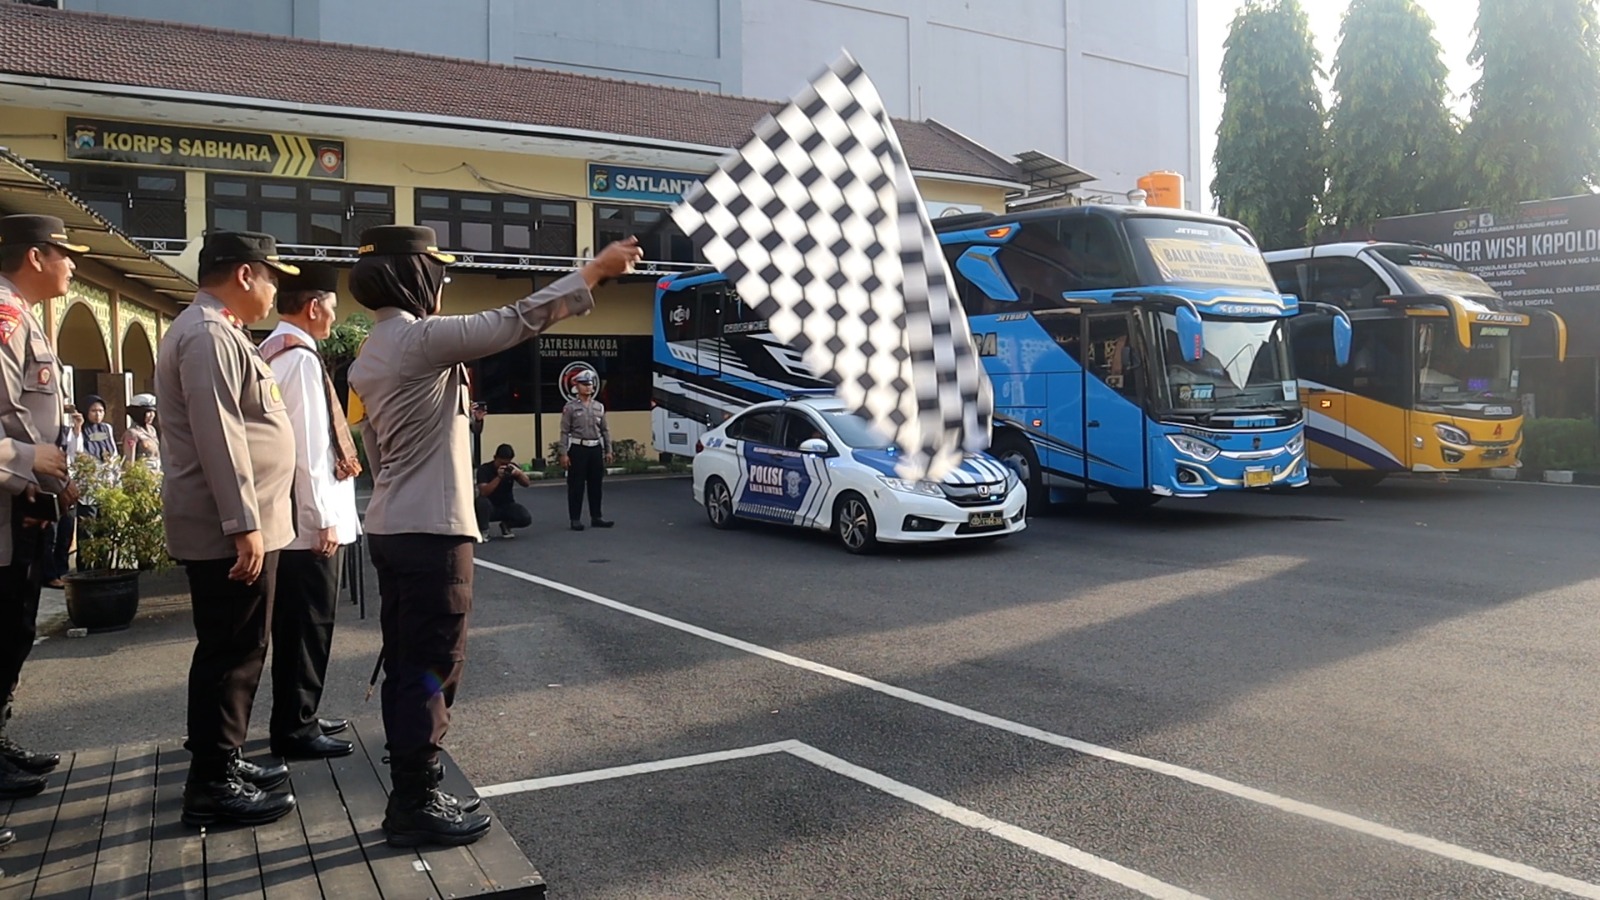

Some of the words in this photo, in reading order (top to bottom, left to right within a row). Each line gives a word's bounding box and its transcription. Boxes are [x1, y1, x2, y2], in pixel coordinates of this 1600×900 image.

[102, 132, 172, 155] KORPS
[178, 138, 272, 162] SABHARA
[615, 174, 692, 194] SATLANT
[1546, 218, 1569, 227] PERAK
[1163, 248, 1195, 262] BALIK
[1430, 240, 1481, 262] ONDER
[1485, 234, 1526, 260] WISH
[1468, 264, 1507, 272] TAQWAAN
[1508, 261, 1538, 269] KEPADA
[1540, 259, 1566, 267] TUHAN
[1568, 257, 1590, 265] YANG
[1496, 269, 1527, 277] UNGGUL
[1503, 288, 1555, 297] PROFESIONAL
[1556, 286, 1573, 294] DAN
[1525, 298, 1554, 307] DIGITAL
[540, 338, 618, 350] SATRESNARKOBA
[973, 332, 997, 356] RA
[750, 464, 783, 486] POLISI
